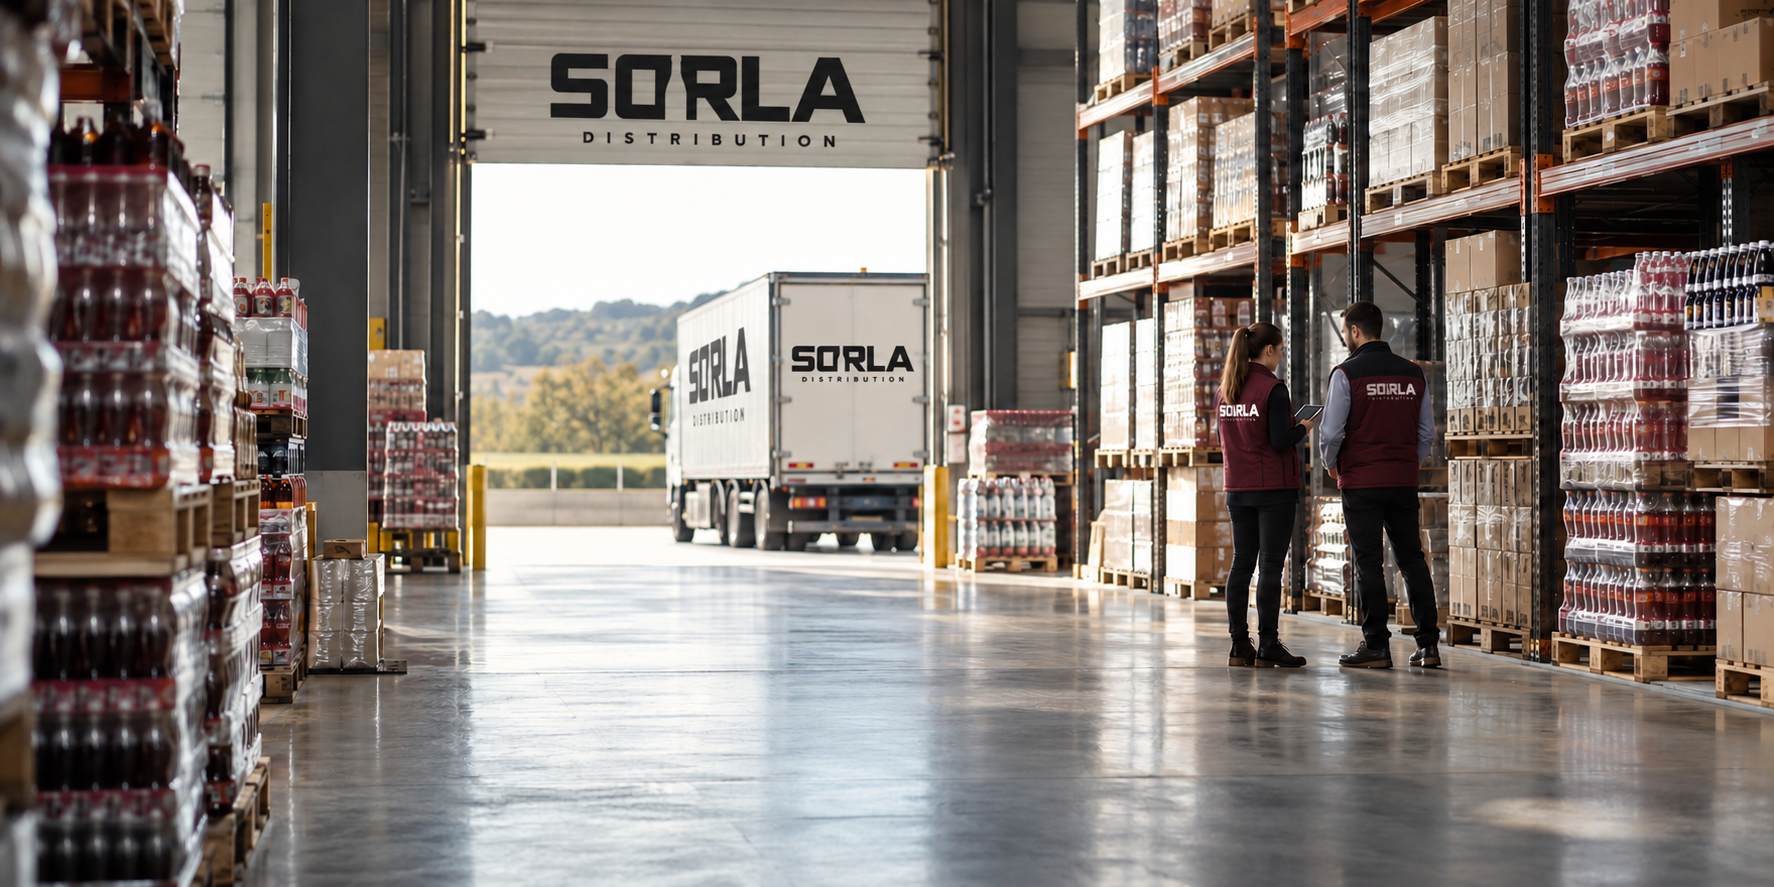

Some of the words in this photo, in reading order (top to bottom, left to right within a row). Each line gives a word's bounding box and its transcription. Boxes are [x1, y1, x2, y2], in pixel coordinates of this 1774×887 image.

[551, 53, 866, 123] SORLA
[583, 131, 836, 147] DISTRIBUTION
[689, 327, 751, 404] SORLA
[792, 346, 914, 372] SORLA
[693, 407, 745, 427] DISTRIBUTION
